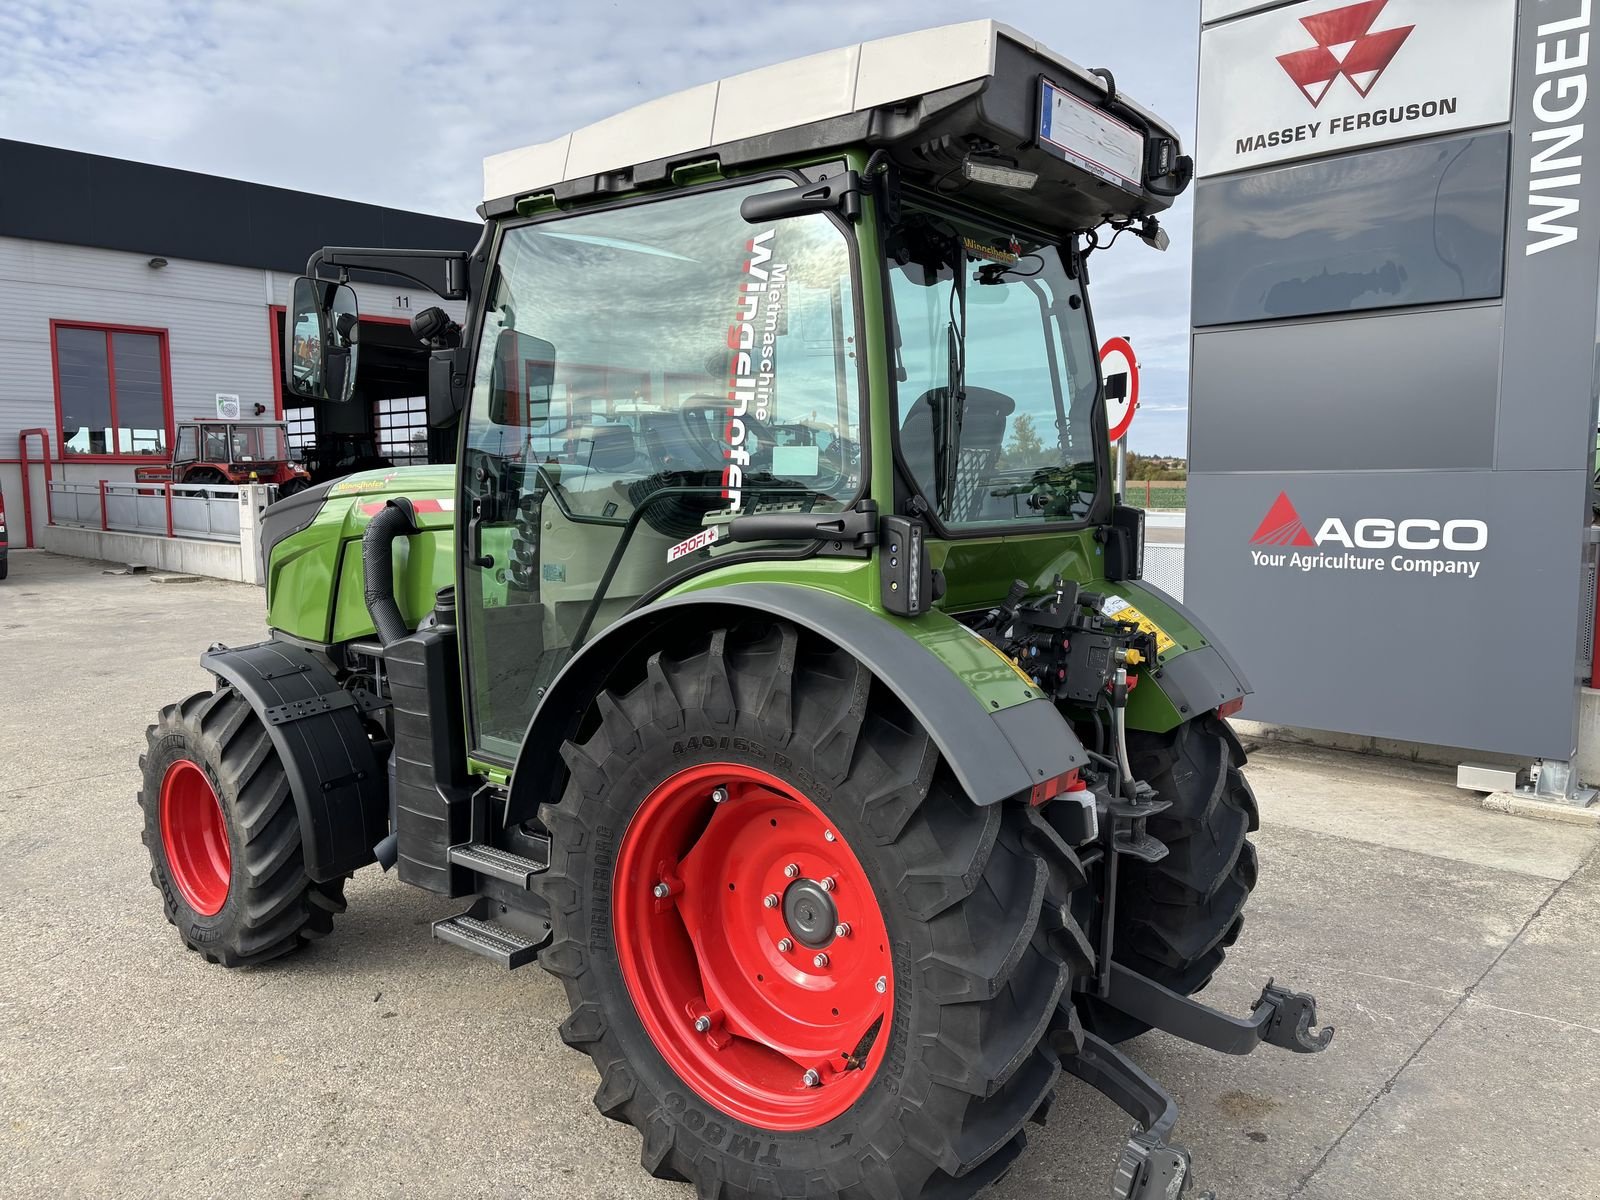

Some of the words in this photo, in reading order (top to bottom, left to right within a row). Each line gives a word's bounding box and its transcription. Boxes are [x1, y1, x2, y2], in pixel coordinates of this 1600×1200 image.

[1235, 121, 1322, 154] MASSEY
[1328, 96, 1458, 135] FERGUSON
[395, 295, 409, 308] 11
[755, 263, 788, 422] Mietmaschine
[672, 532, 706, 559] PROFI
[1313, 517, 1489, 551] AGCO
[1250, 550, 1287, 568] Your
[1289, 551, 1386, 572] Agriculture
[1390, 554, 1481, 579] Company
[589, 824, 614, 955] TRELLEBORG
[663, 1090, 782, 1168] TM800
